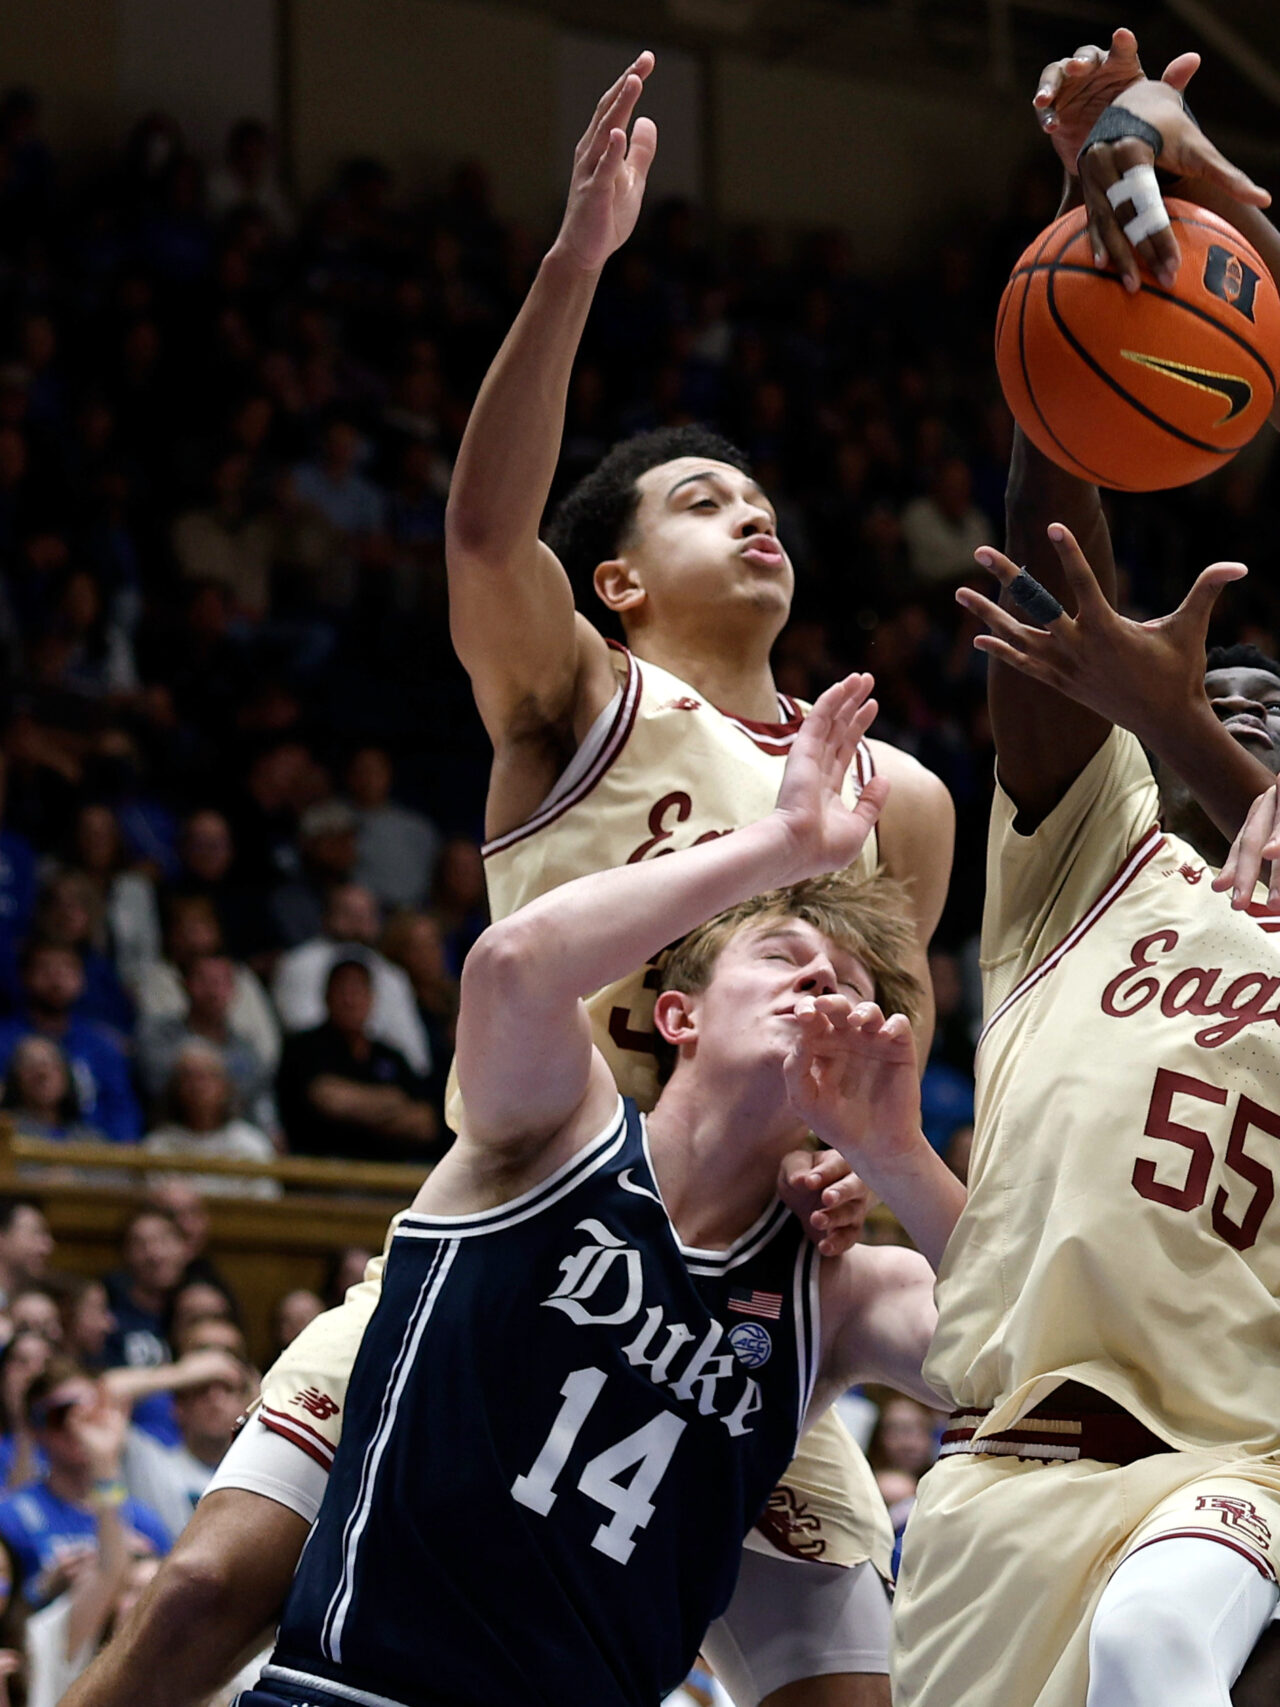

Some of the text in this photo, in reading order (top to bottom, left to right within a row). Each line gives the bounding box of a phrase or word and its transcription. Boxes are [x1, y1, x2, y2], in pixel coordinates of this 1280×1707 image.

[539, 1218, 762, 1437] Duke
[733, 1337, 769, 1353] ACC
[510, 1366, 688, 1566] 14
